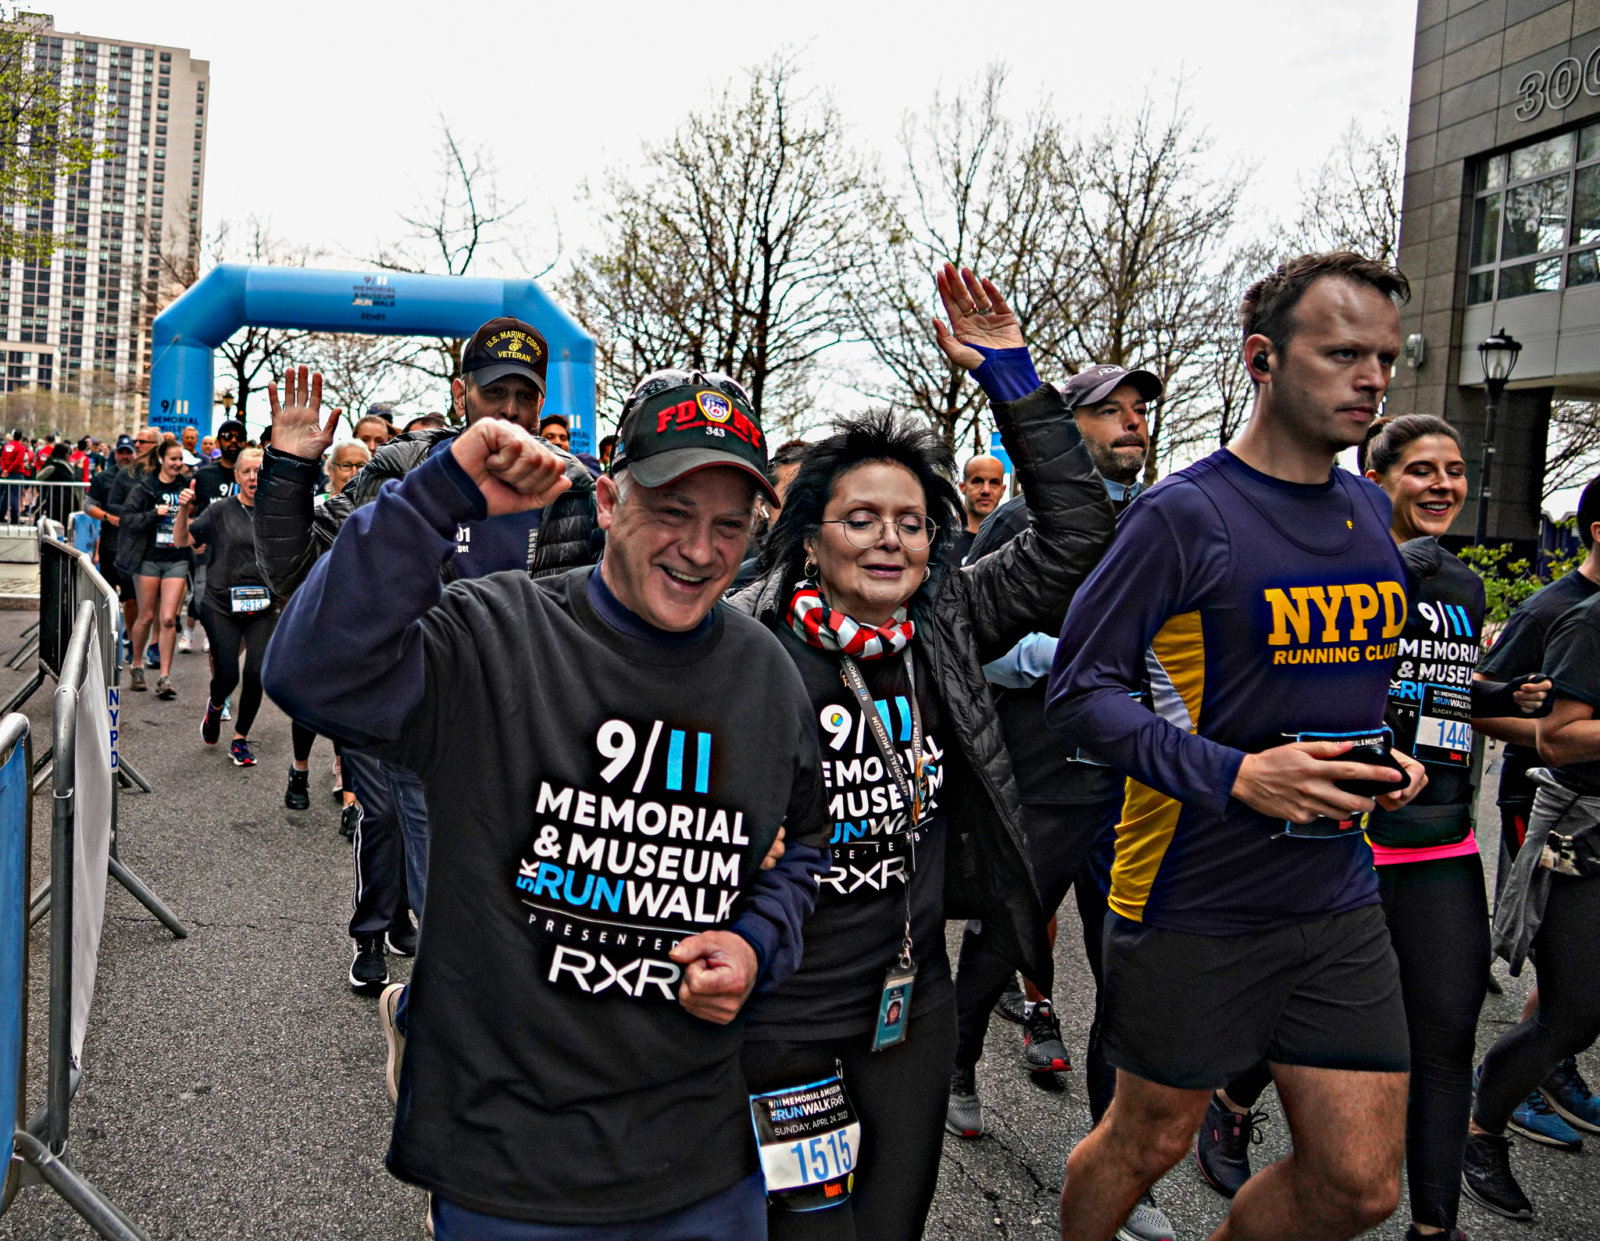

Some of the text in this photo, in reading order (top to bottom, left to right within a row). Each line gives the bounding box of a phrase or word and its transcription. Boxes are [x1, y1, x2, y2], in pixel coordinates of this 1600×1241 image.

[485, 330, 543, 356] U.S. MARINE CORPS
[497, 350, 532, 363] VETERAN
[160, 398, 189, 415] 9/11
[151, 416, 200, 427] MEMORIAL
[705, 426, 726, 438] 343
[219, 482, 239, 497] 9/1
[240, 600, 263, 611] 2913
[1264, 581, 1408, 646] NYPD
[1417, 600, 1473, 639] 9/11
[1273, 642, 1397, 665] RUNNING CLUB
[1397, 638, 1480, 665] MEMORIA
[1397, 661, 1474, 685] & MUSEU
[108, 688, 119, 768] NYPD
[871, 715, 890, 749] MUSEUM
[596, 720, 712, 793] 9/11
[535, 781, 749, 845] MEMORIAL
[533, 825, 741, 886] & MUSEUM
[516, 858, 540, 892] 5K
[814, 857, 909, 894] RXR
[548, 944, 681, 1000] RXR
[769, 1099, 782, 1108] 9/11
[782, 1092, 820, 1106] MEMORIAL
[824, 1085, 841, 1096] MUSEUM
[830, 1095, 845, 1108] RXR
[774, 1123, 811, 1136] SUNDAY,
[812, 1118, 829, 1128] APRIL
[790, 1129, 852, 1184] 1515
